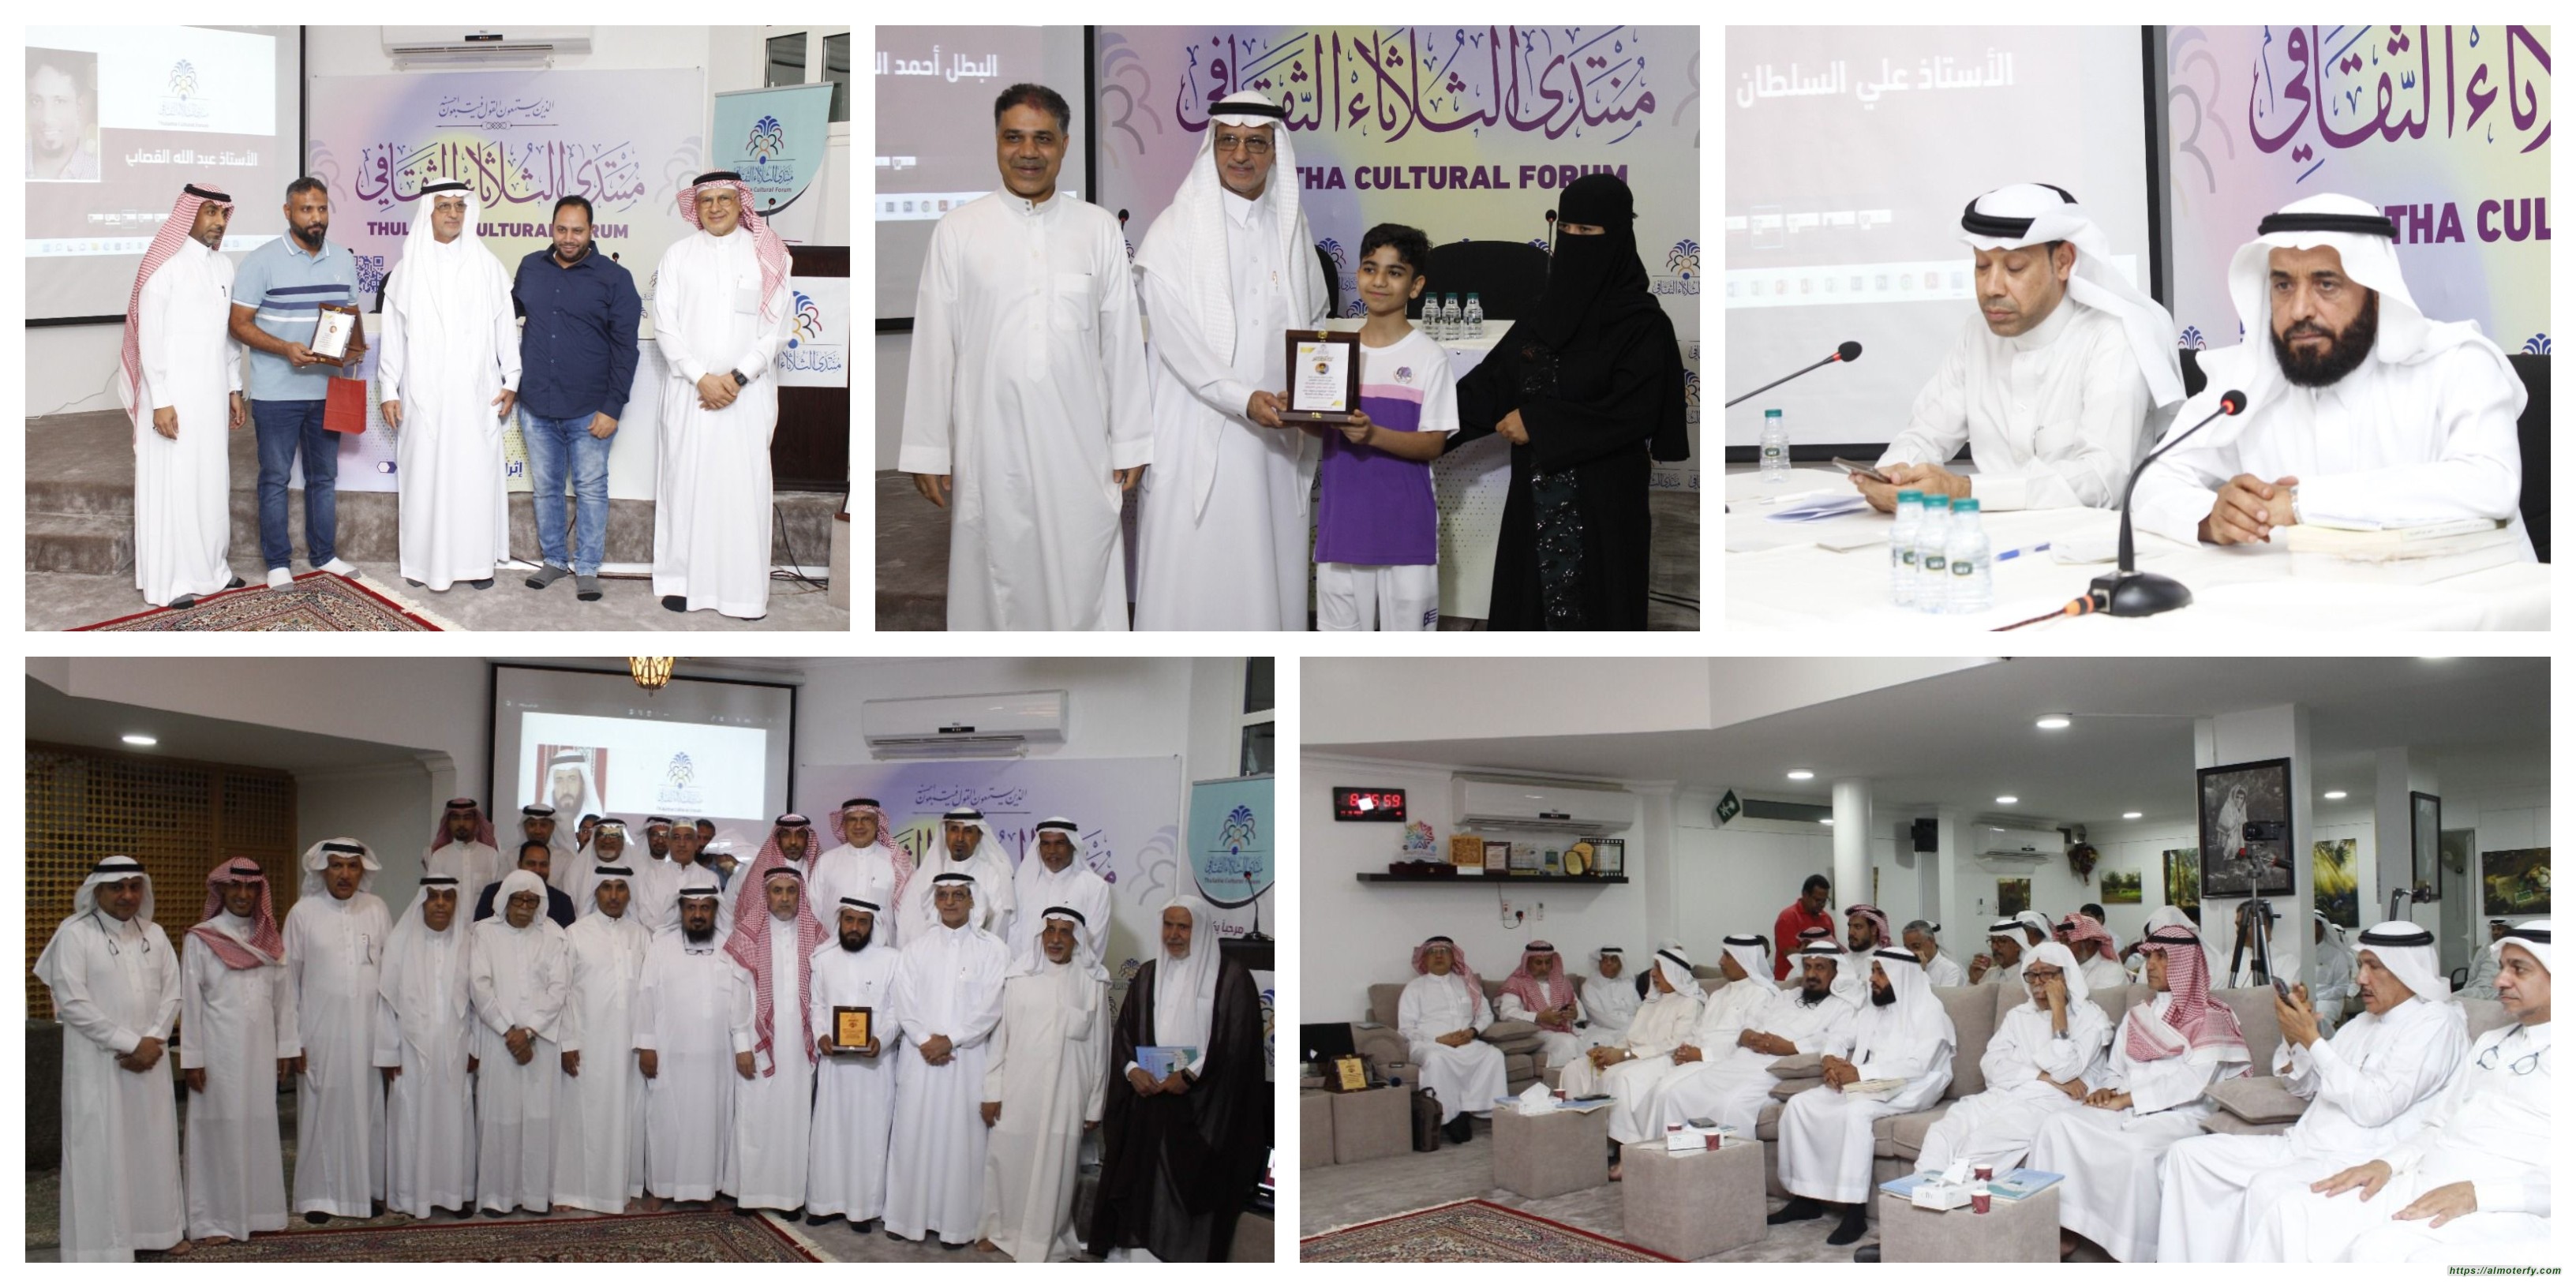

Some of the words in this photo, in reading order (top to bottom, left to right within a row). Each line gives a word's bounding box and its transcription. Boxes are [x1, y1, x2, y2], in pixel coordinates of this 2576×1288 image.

[894, 45, 939, 75] أحمد
[945, 53, 997, 83] البطل
[1918, 47, 2014, 90] الأستاذ
[1736, 59, 1847, 107] السلطان
[1856, 58, 1909, 110] علي
[125, 148, 170, 167] القصاب
[173, 150, 193, 164] الله
[197, 154, 216, 168] عبد
[219, 149, 258, 167] الأستاذ
[1297, 167, 1346, 189] THA
[1354, 165, 1511, 190] CULTURAL
[367, 222, 410, 236] THUL
[476, 222, 553, 238] ULTURA
[592, 223, 629, 238] RUM
[2387, 202, 2466, 245] THA
[2477, 197, 2551, 243] CUL
[505, 460, 522, 477] إثرا
